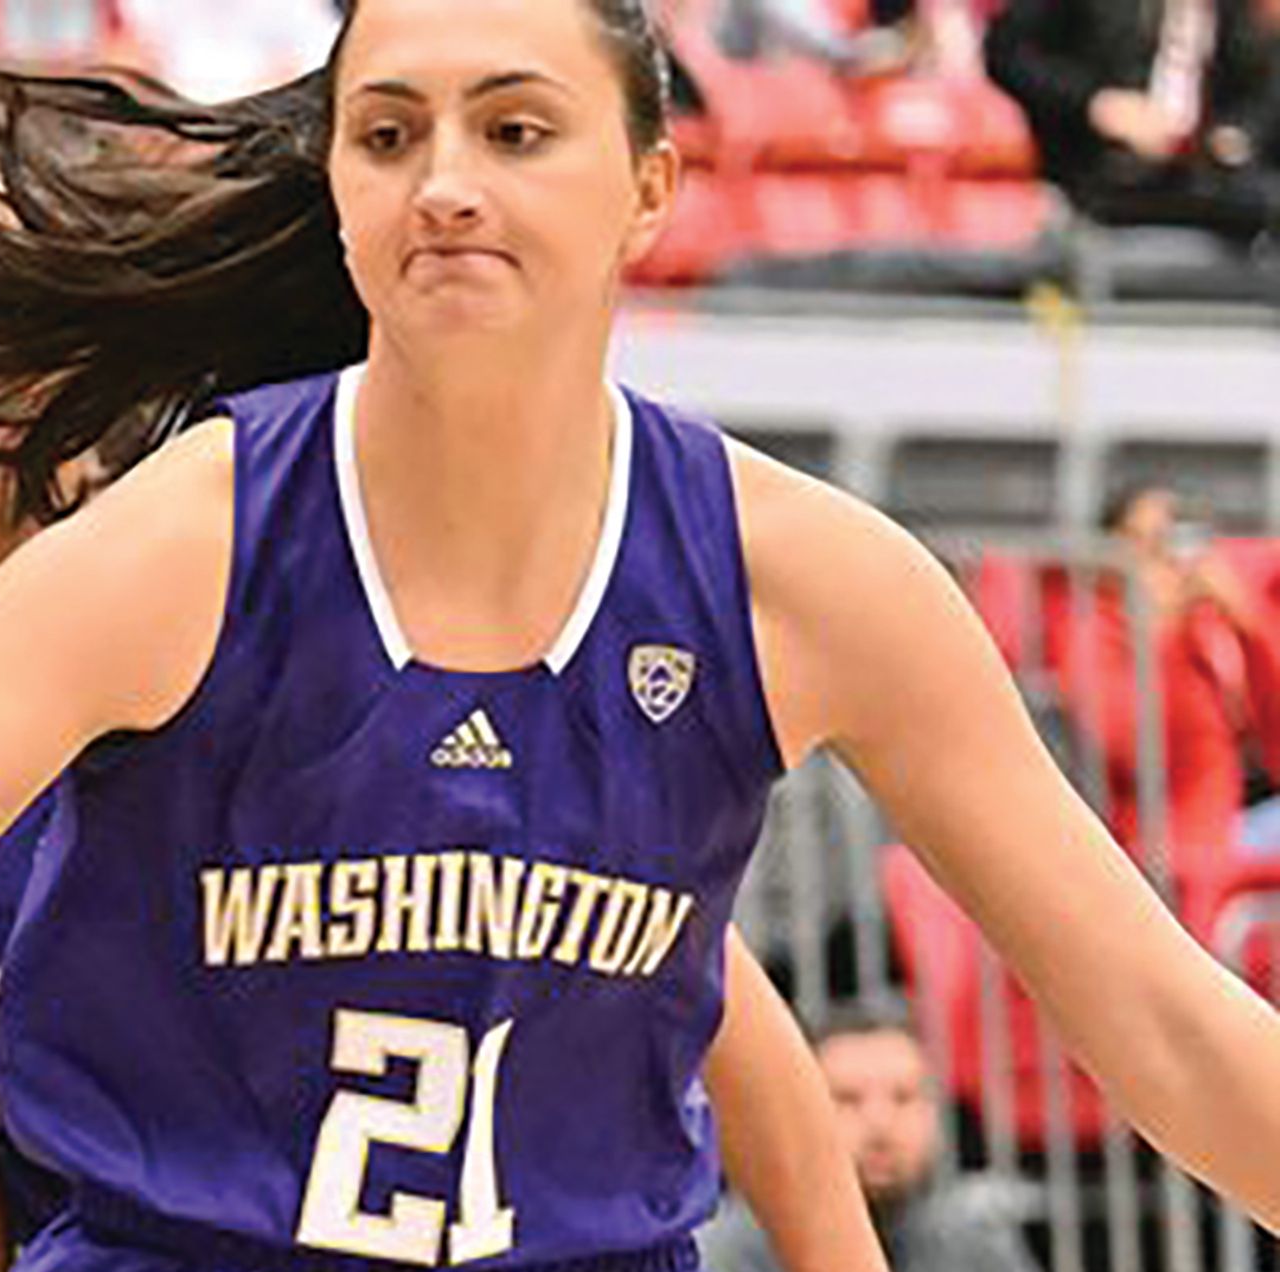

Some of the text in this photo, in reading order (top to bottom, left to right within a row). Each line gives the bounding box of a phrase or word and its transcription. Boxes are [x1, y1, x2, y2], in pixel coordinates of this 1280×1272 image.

[429, 747, 513, 768] adidas
[200, 850, 694, 977] WASHINGTON
[295, 1008, 515, 1267] 21
